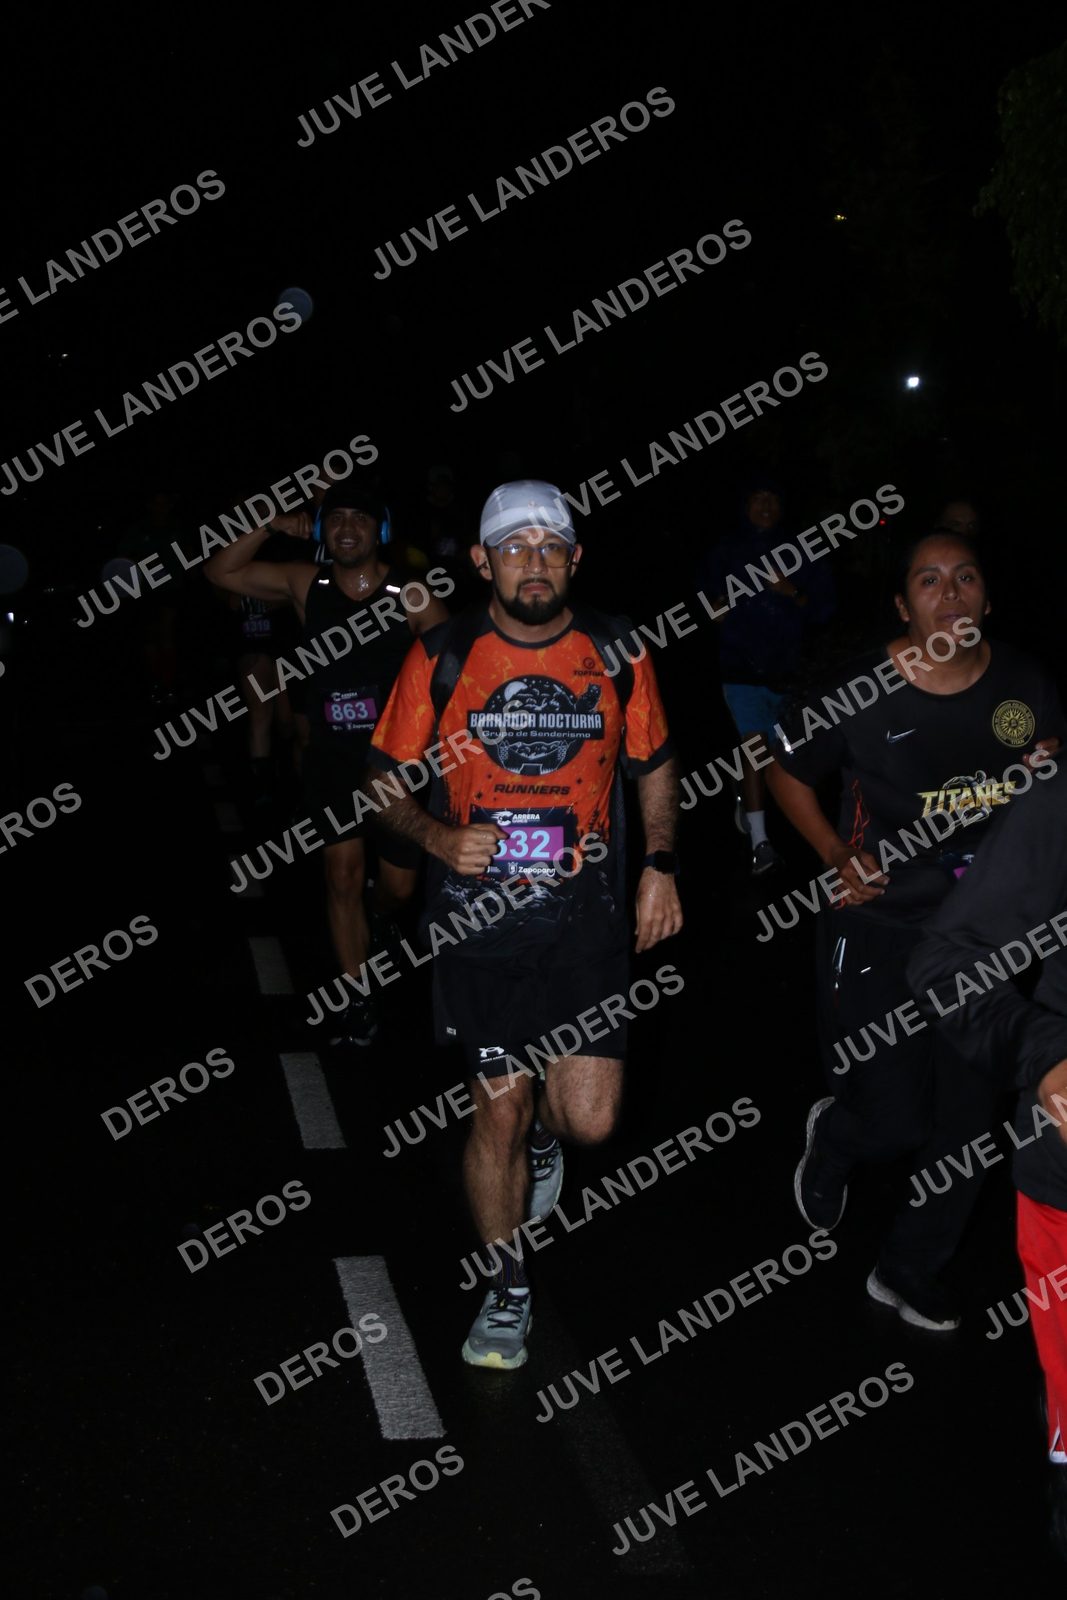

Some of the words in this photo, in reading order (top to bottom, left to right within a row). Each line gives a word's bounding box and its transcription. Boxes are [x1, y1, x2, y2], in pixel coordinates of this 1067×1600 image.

[331, 701, 368, 721] 863
[470, 713, 536, 728] BARRANCA
[539, 713, 602, 729] NOCTURNA
[482, 730, 514, 739] Grupo
[530, 730, 591, 738] Senderismo
[494, 784, 571, 795] RUNNERS
[917, 781, 1016, 818] TITANES
